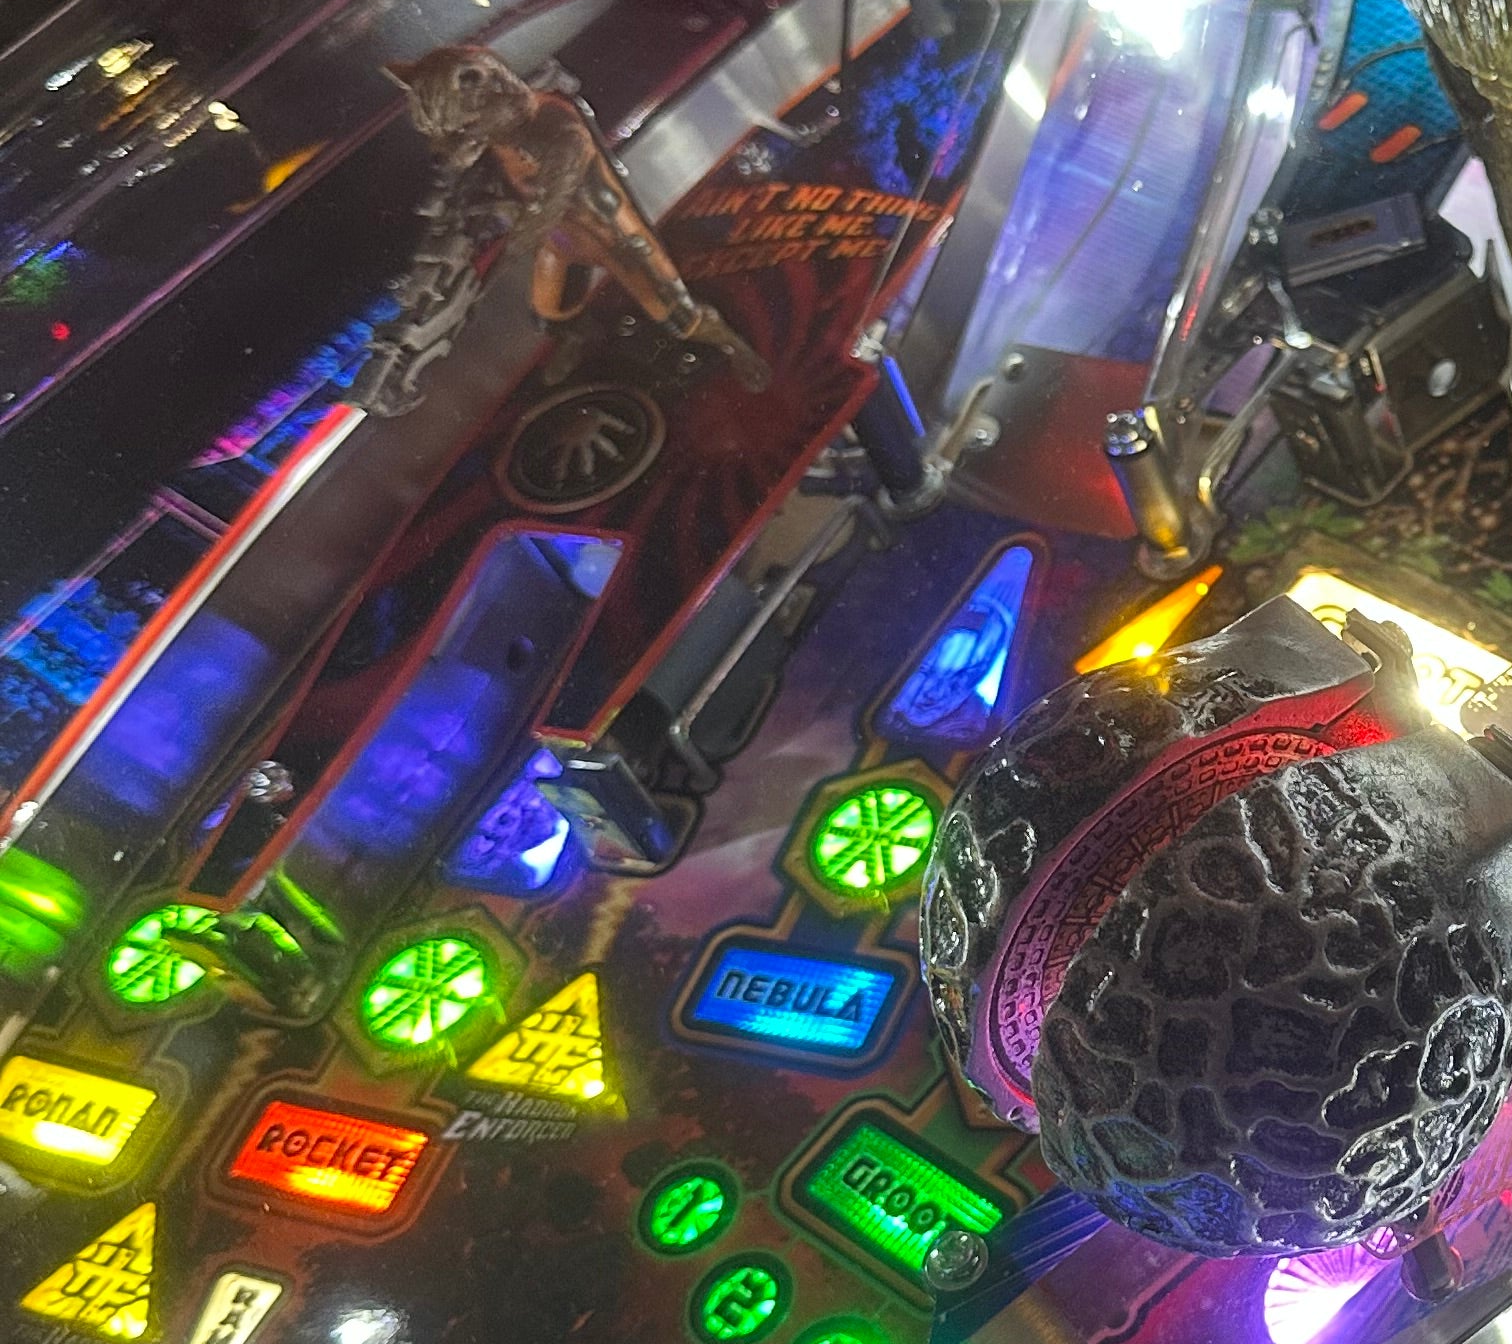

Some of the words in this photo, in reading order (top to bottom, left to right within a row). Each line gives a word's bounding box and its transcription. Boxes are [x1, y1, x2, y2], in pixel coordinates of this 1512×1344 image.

[784, 182, 845, 211] NO
[716, 970, 865, 1023] NEBULA
[256, 1122, 408, 1181] ROCKET
[842, 1156, 946, 1237] GROO
